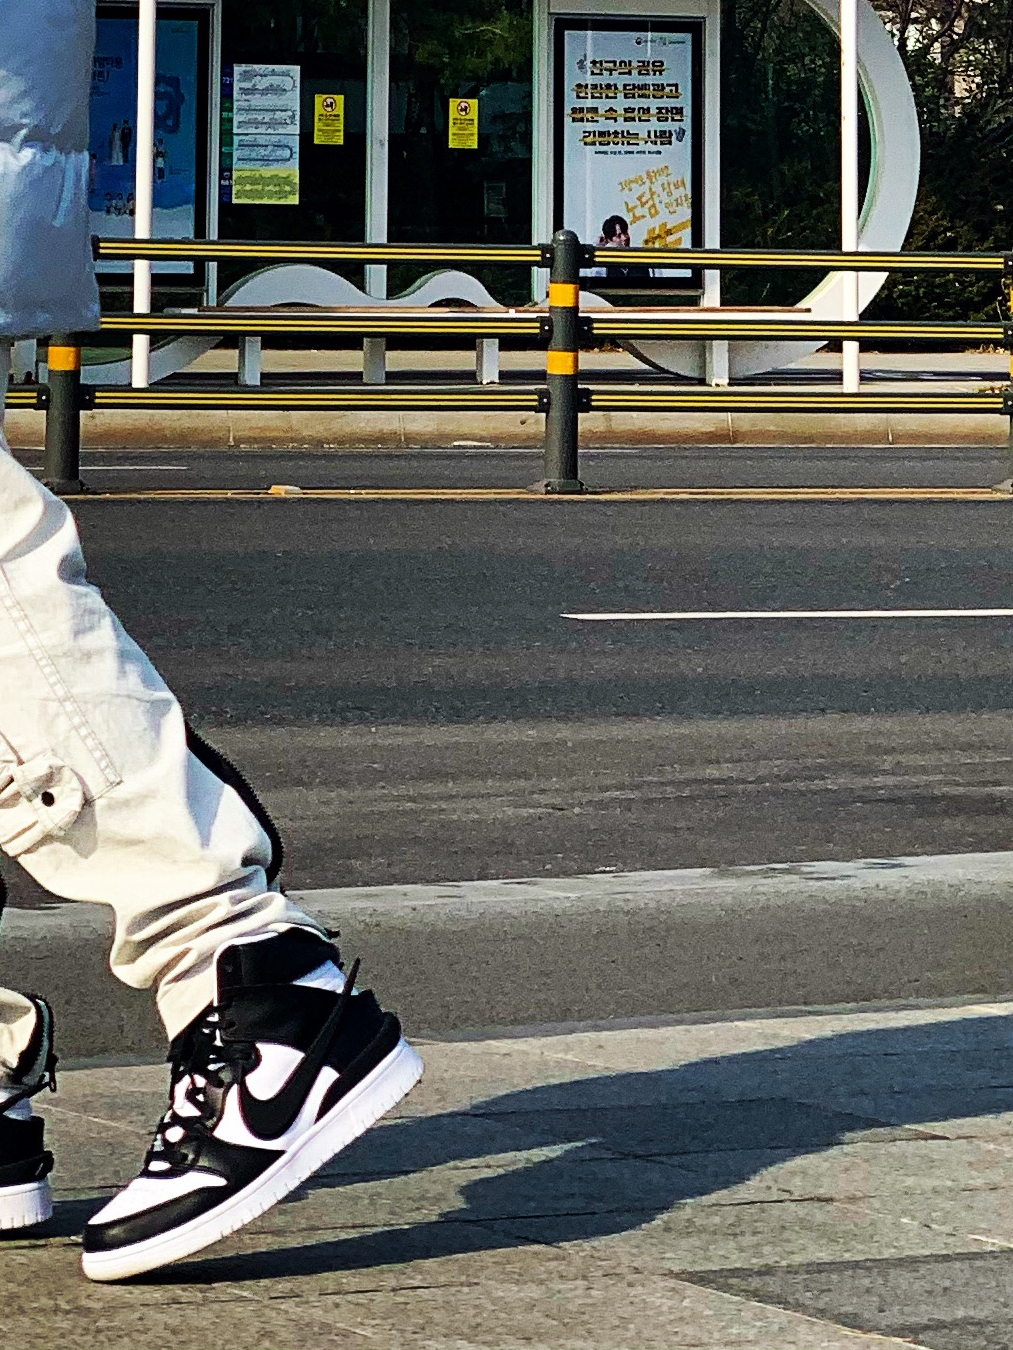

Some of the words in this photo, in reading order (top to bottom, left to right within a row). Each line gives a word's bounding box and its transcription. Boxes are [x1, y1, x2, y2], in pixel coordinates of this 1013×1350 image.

[590, 59, 632, 76] 친구의
[637, 60, 665, 76] 권유
[575, 83, 618, 99] 현란한
[623, 83, 680, 100] 담배광고
[570, 106, 599, 123] 웹툰
[604, 106, 618, 123] 속
[623, 106, 651, 123] 흡연
[656, 106, 684, 123] 장면
[646, 130, 673, 146] 사람
